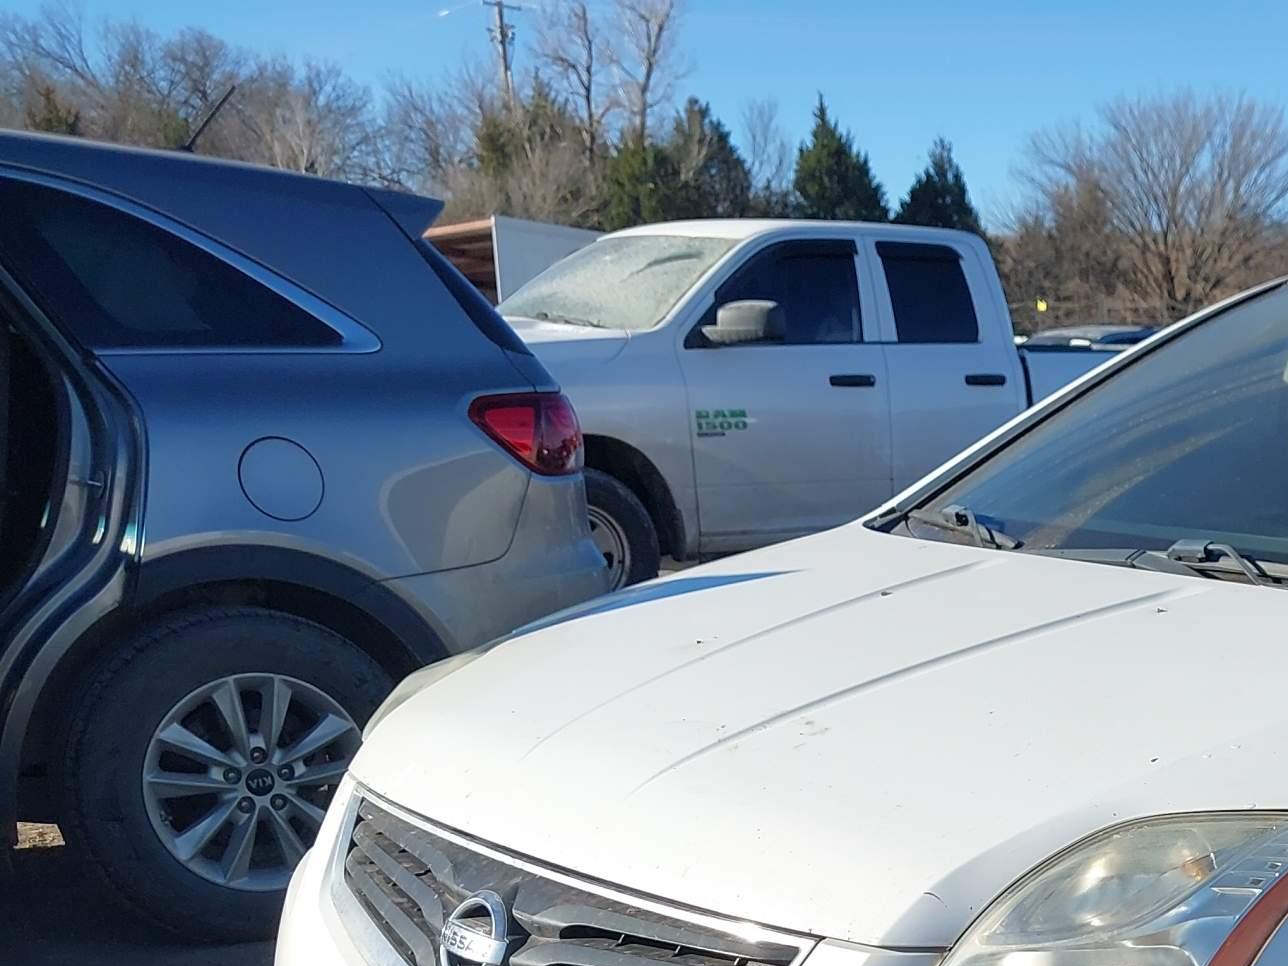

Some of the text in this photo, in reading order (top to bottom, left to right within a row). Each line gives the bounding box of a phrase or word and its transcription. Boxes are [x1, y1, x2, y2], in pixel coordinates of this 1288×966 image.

[696, 409, 747, 419] RAM
[697, 420, 748, 431] 1500
[248, 776, 272, 788] KIA
